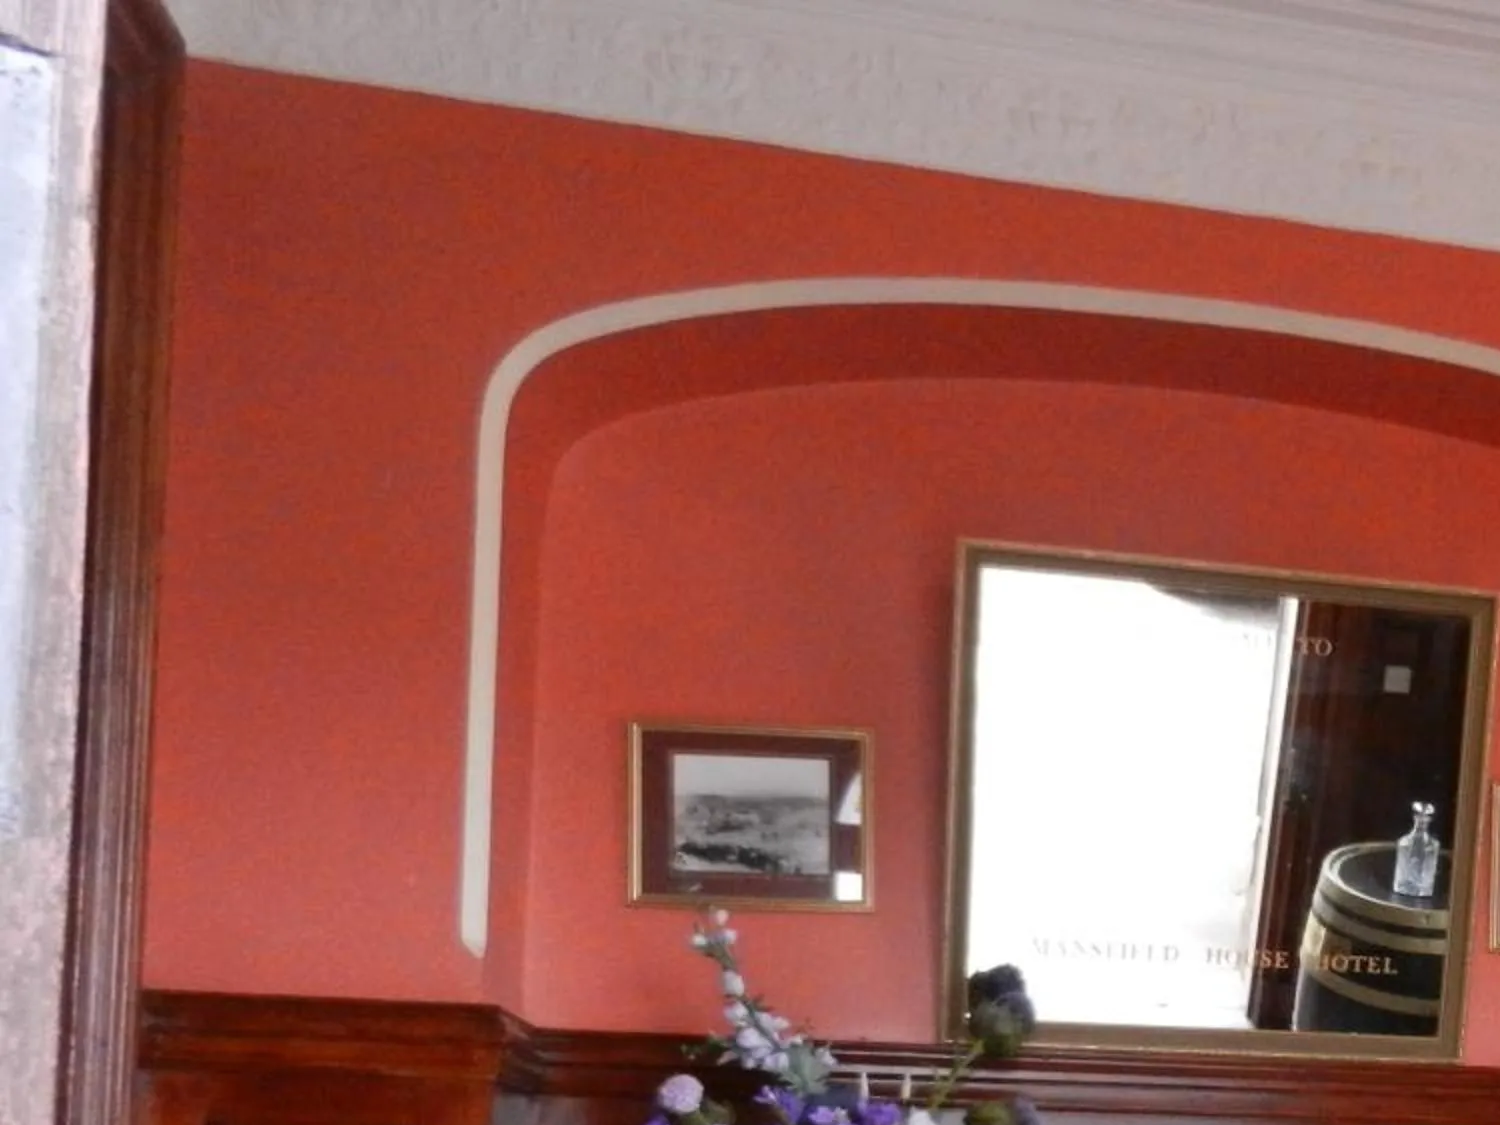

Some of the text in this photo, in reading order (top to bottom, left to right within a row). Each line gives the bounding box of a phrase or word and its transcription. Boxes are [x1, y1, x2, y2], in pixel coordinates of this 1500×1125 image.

[1297, 637, 1333, 656] TO
[1032, 938, 1399, 975] MANSFIELD HOUSE HOTEL
